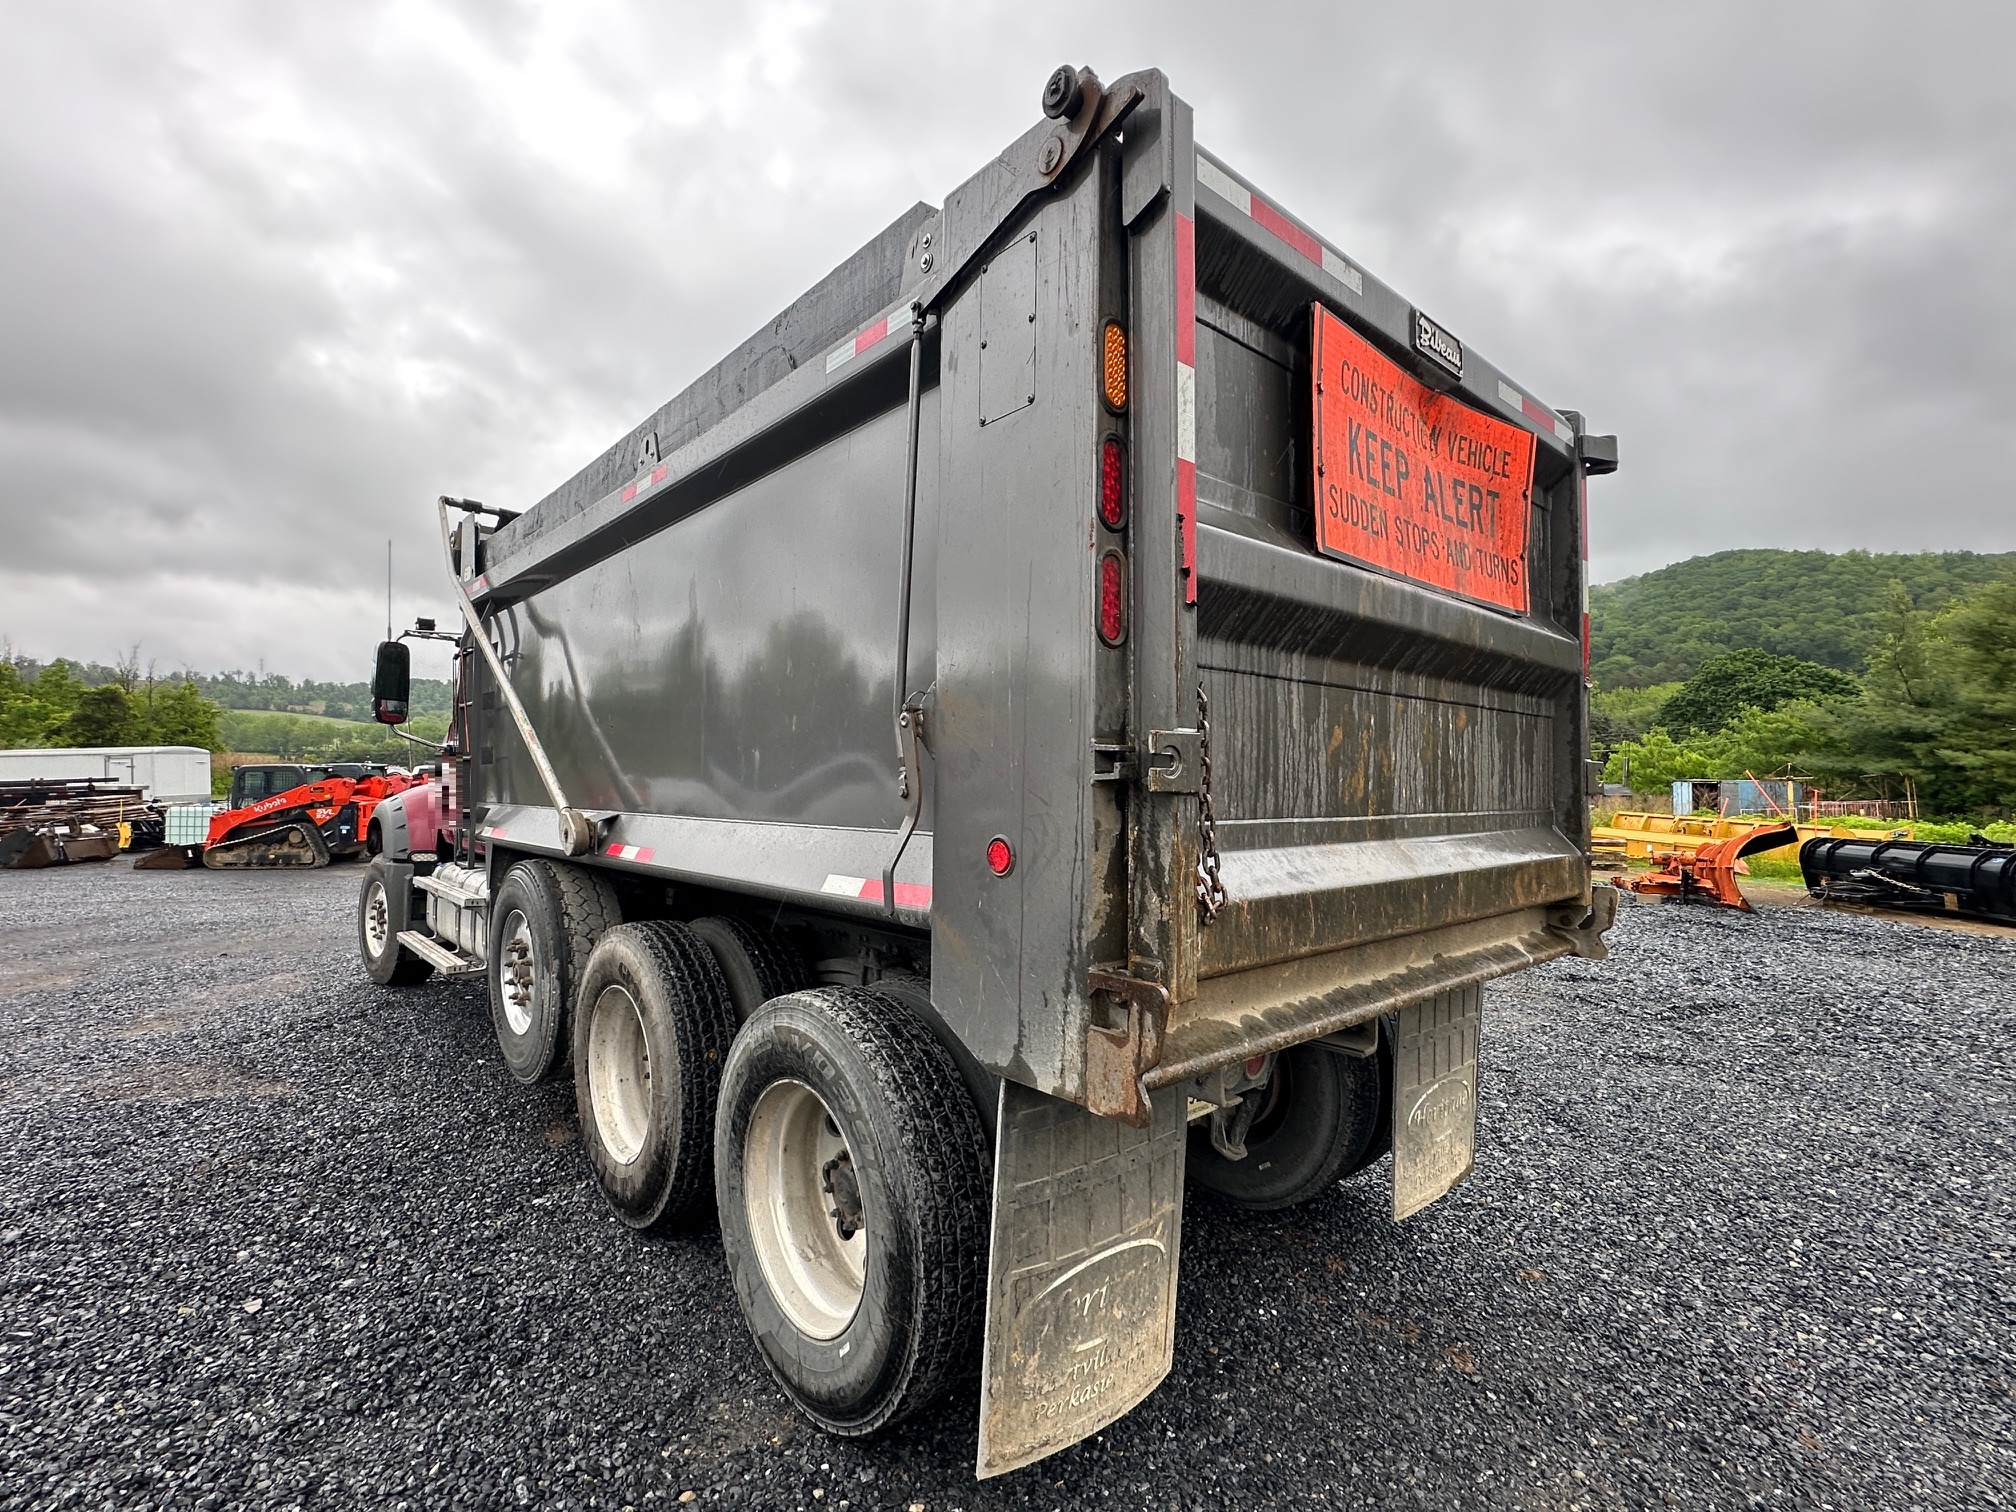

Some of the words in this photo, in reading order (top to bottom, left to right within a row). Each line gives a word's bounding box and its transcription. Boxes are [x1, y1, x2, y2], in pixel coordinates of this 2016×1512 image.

[1419, 316, 1461, 368] Bibeau
[1348, 416, 1410, 501] KEEP
[1423, 465, 1500, 539] ALERT
[1448, 430, 1512, 479] VEHICLE
[1329, 483, 1389, 541] SUDDEN
[1395, 515, 1440, 561] STOPS
[1446, 537, 1471, 571] AND
[1476, 548, 1519, 586] TURNS
[253, 797, 287, 813] Kubota
